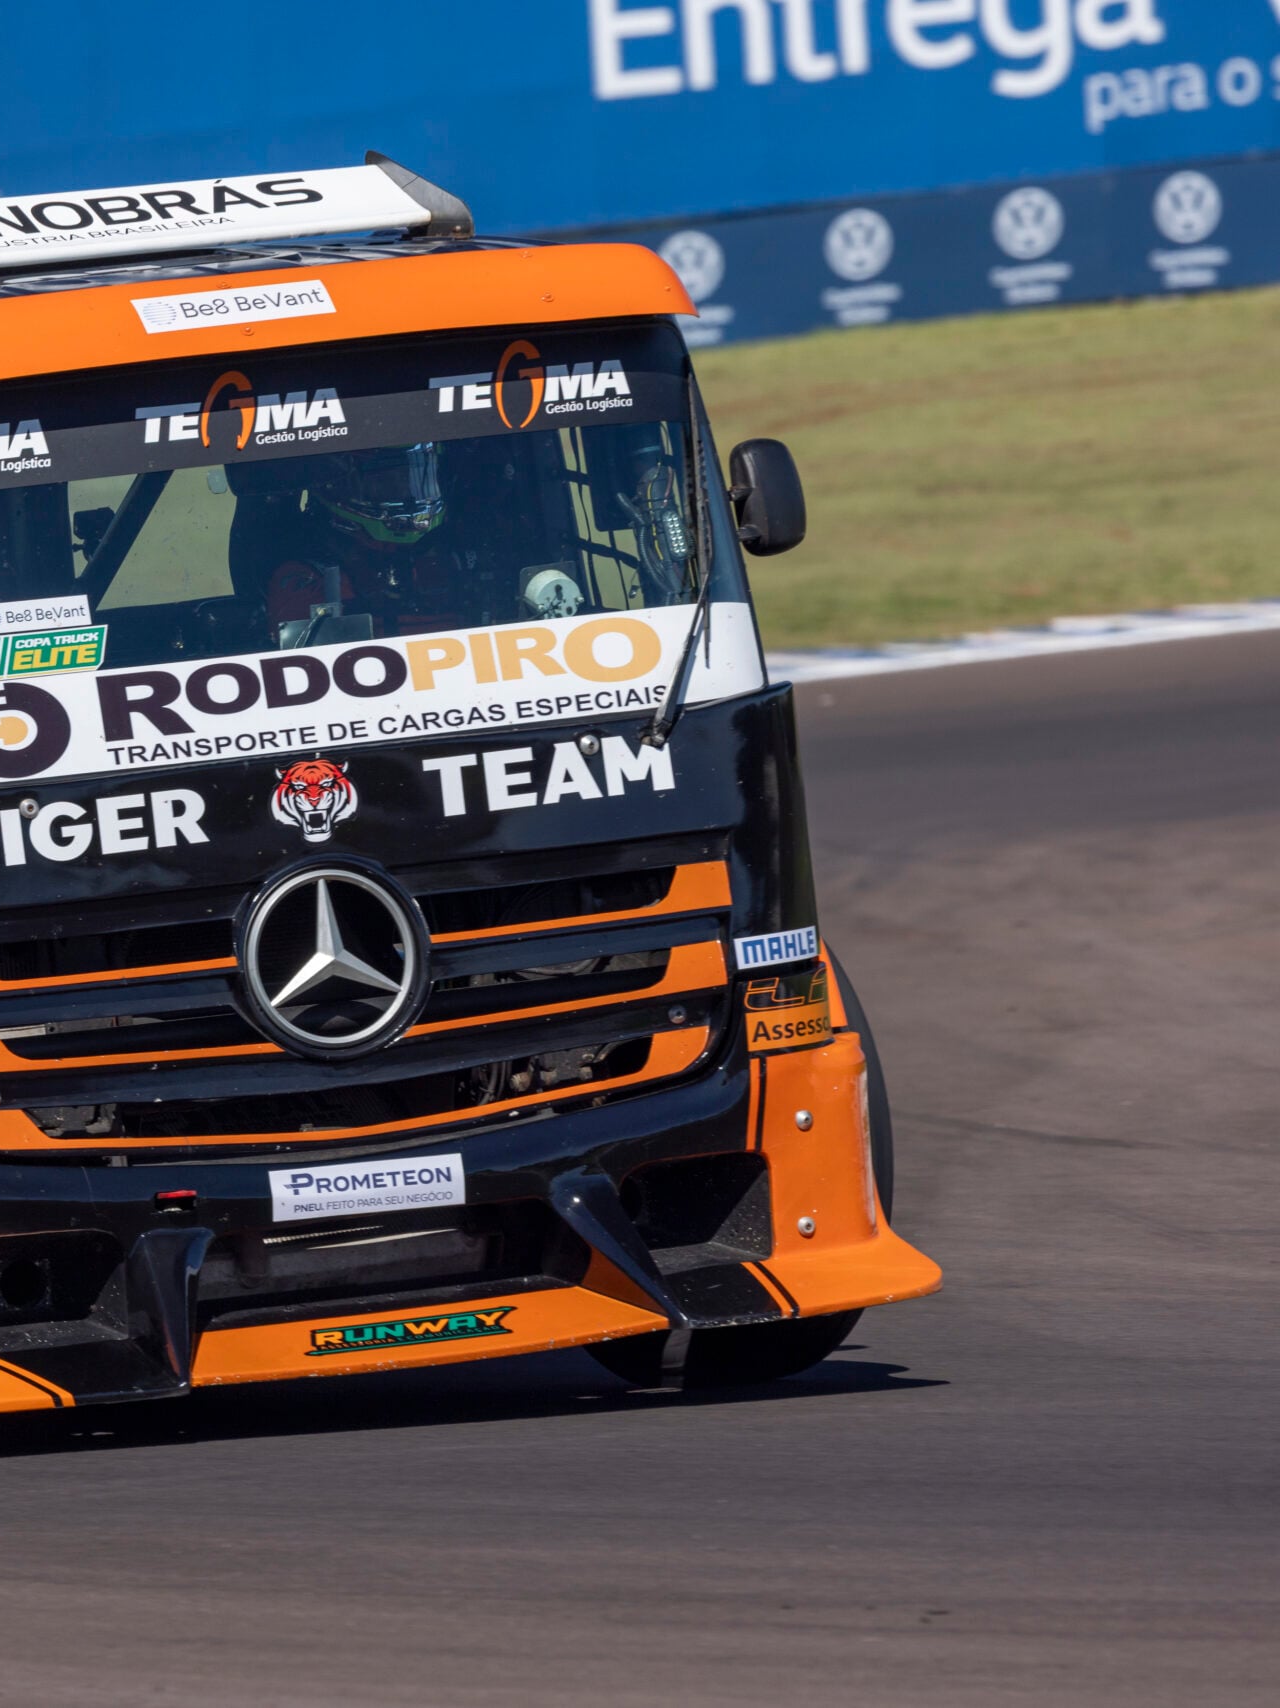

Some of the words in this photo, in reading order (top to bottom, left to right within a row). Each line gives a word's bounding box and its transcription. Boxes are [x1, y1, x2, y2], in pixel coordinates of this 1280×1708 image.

[590, 0, 1165, 101] Entrega
[1083, 58, 1209, 134] para
[1219, 57, 1262, 106] o
[87, 217, 236, 239] BRASILEIRA
[180, 299, 229, 319] Be8
[234, 288, 325, 313] BeVant
[429, 339, 631, 429] TEGMA
[135, 370, 347, 451] TEGMA
[545, 401, 584, 415] Gestão
[586, 396, 634, 413] Logística
[255, 431, 296, 446] Gestão
[298, 426, 348, 443] Logística
[1, 457, 52, 474] Logística
[5, 609, 33, 623] Be8
[35, 605, 86, 620] BeVant
[14, 636, 51, 649] COPA
[53, 632, 99, 645] TRUCK
[12, 643, 98, 671] ELITE
[95, 617, 662, 743] RODOPIRO
[107, 726, 318, 766] TRANSPORTE
[328, 720, 368, 741] DE
[378, 704, 506, 735] CARGAS
[516, 685, 668, 719] ESPECIAIS
[422, 736, 676, 817] TEAM
[742, 930, 815, 965] MAHLE
[284, 1166, 453, 1196] PROMETEON
[326, 1200, 355, 1211] FEITO
[357, 1197, 384, 1208] PARA
[385, 1195, 405, 1206] SEU
[407, 1191, 454, 1204] NEGÓCIO
[315, 1311, 504, 1346] RUNWAY
